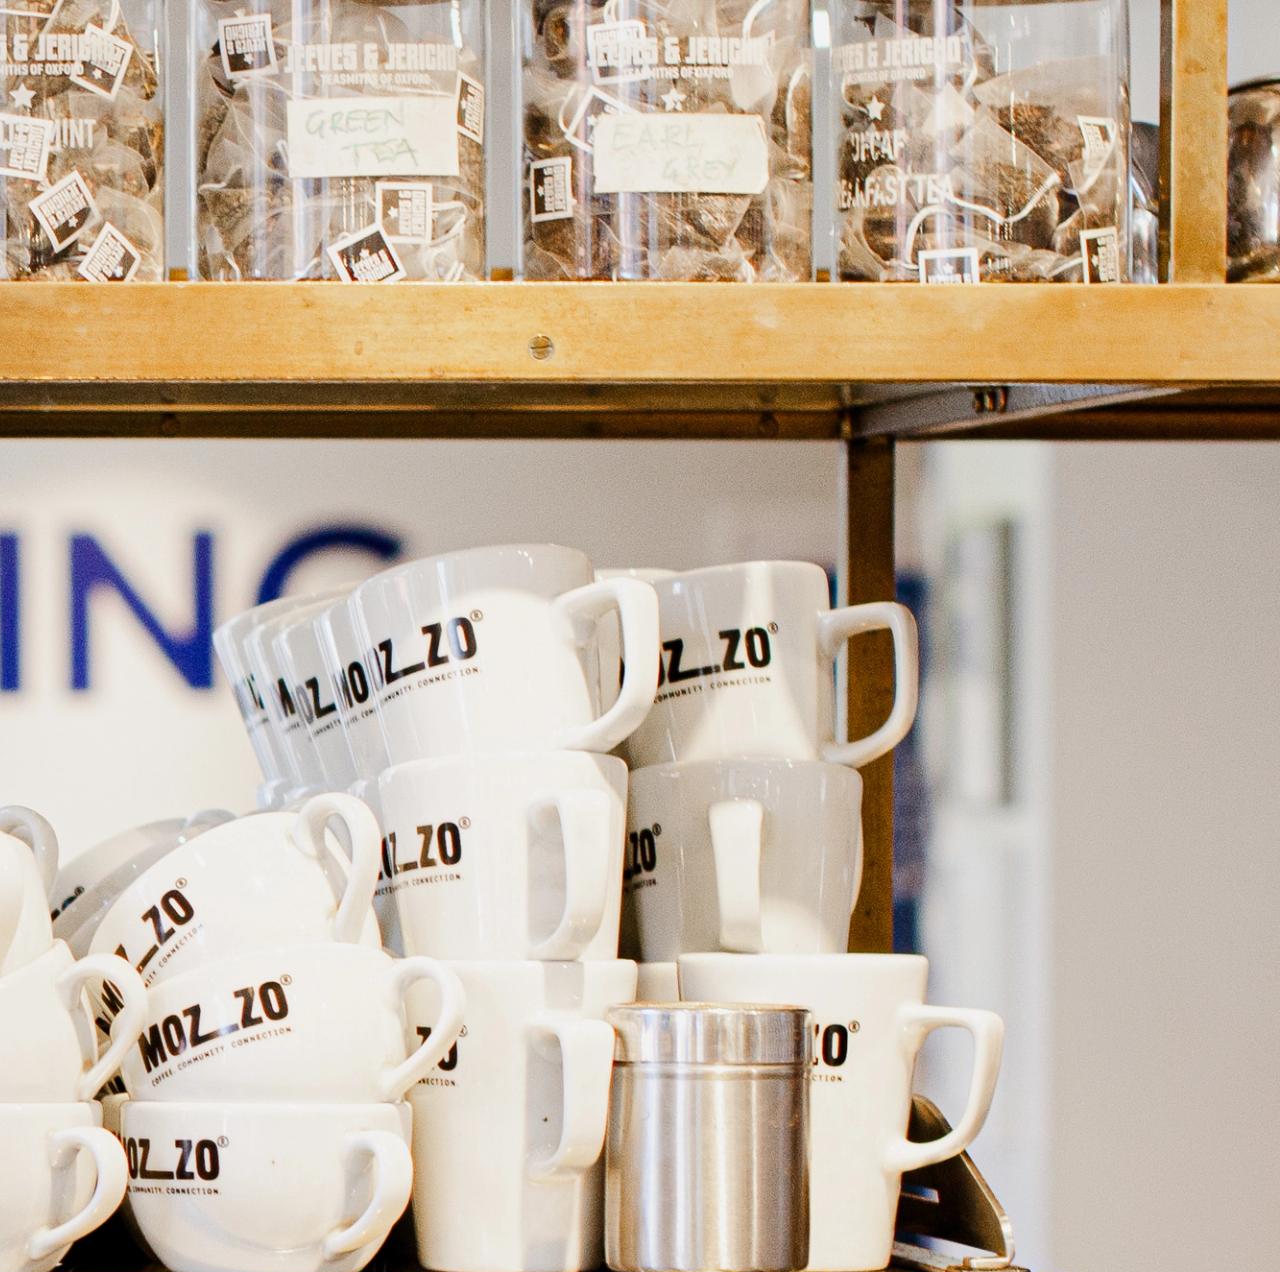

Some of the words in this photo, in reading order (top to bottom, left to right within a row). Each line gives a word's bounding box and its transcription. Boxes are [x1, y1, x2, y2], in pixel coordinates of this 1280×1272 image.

[305, 109, 405, 139] GREEN
[611, 123, 704, 151] EARL
[342, 139, 418, 168] TEA
[661, 157, 737, 180] GREY
